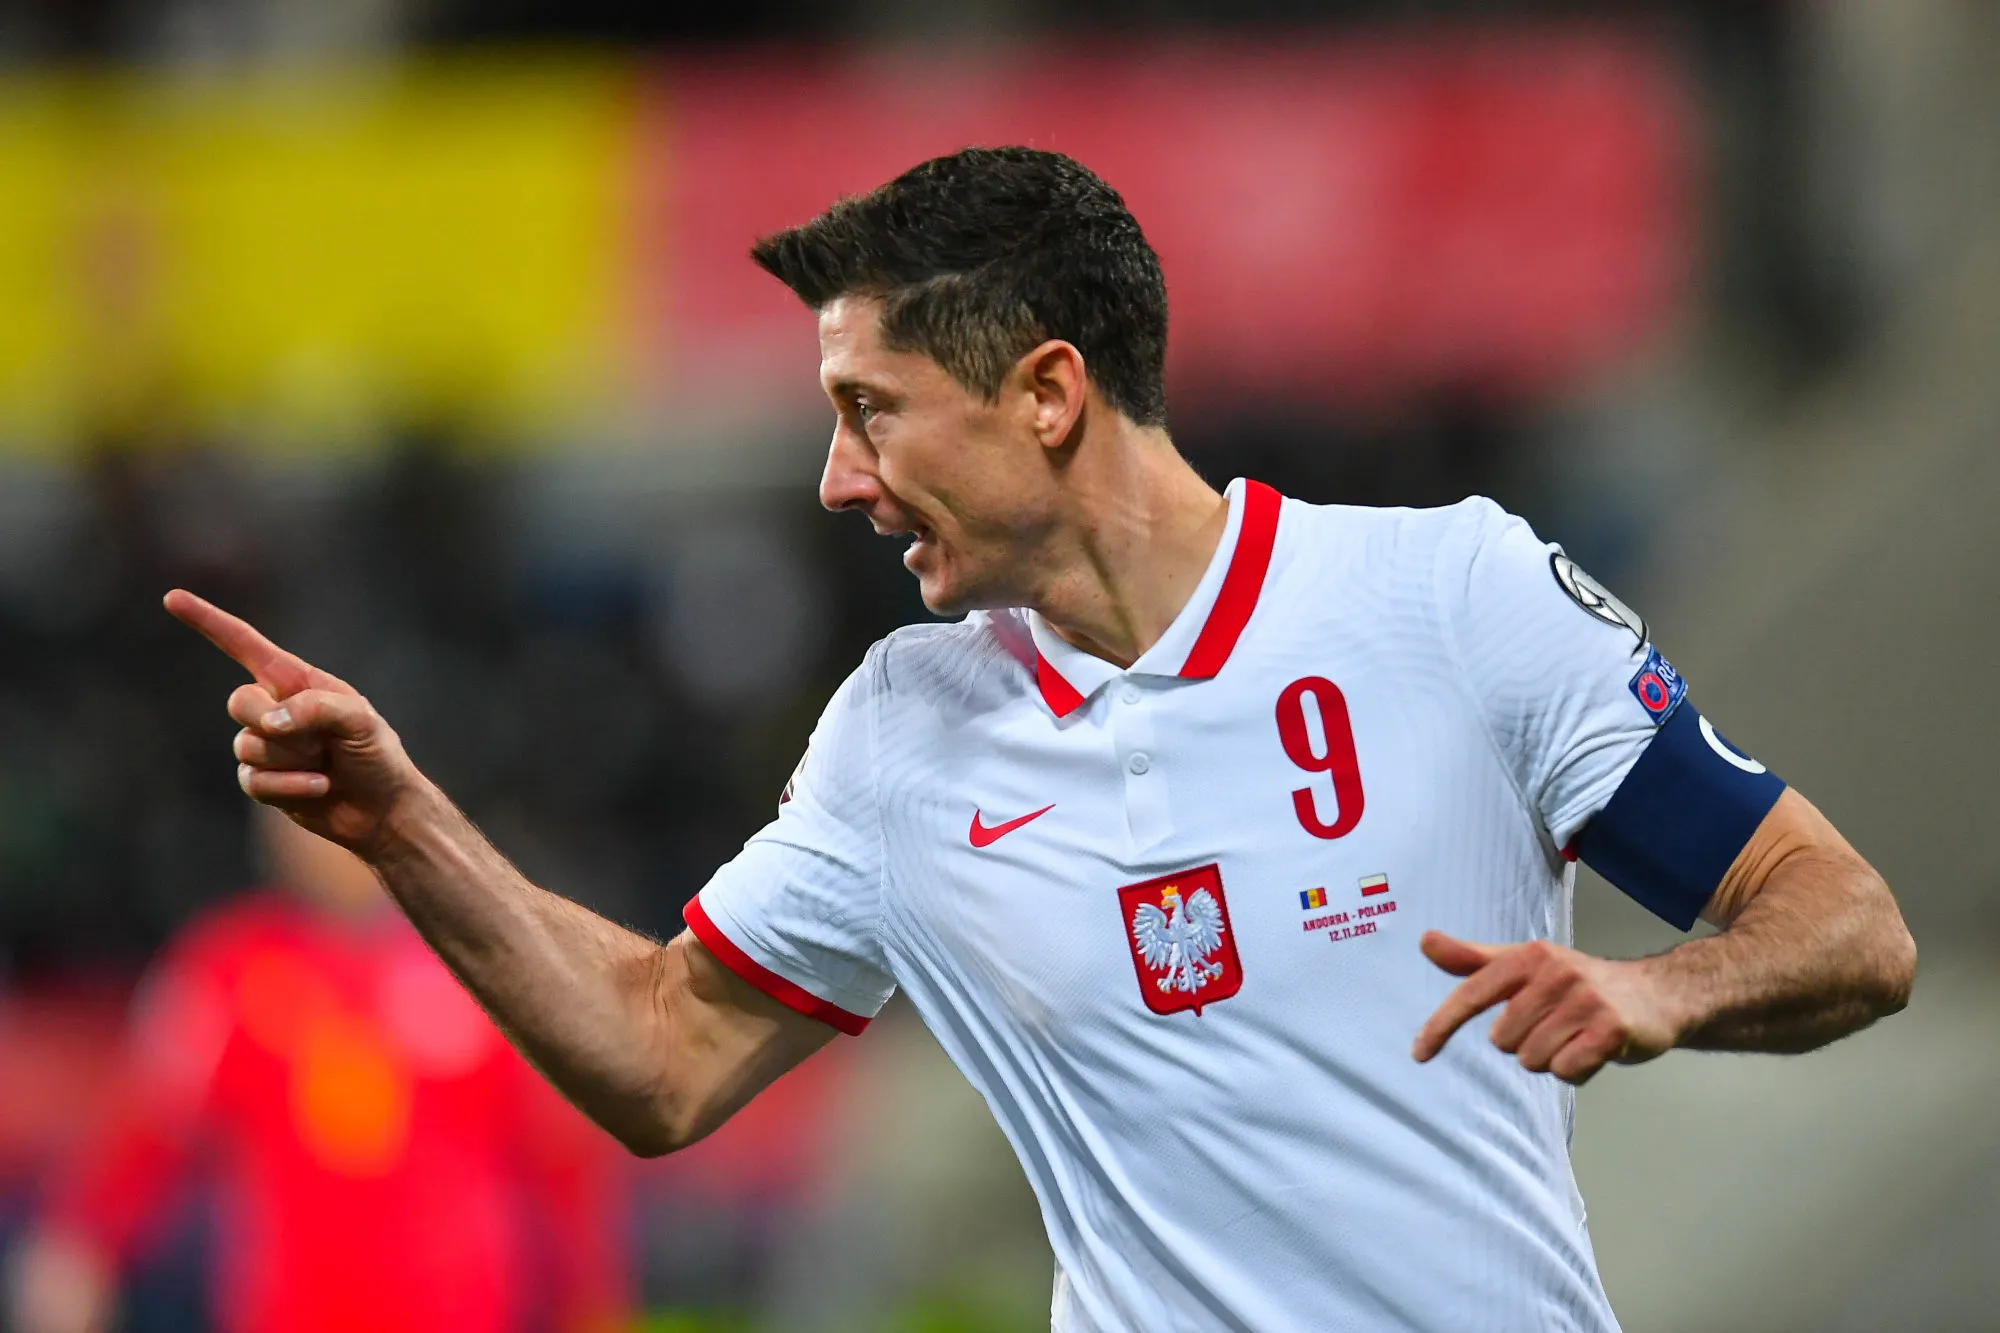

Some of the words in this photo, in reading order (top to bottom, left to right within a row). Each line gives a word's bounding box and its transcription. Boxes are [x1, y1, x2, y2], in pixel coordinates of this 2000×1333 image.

[1275, 675, 1365, 840] 9
[1303, 912, 1349, 931] ANDORRA
[1358, 901, 1397, 919] POLAND
[1329, 922, 1377, 942] 12.11.2021
